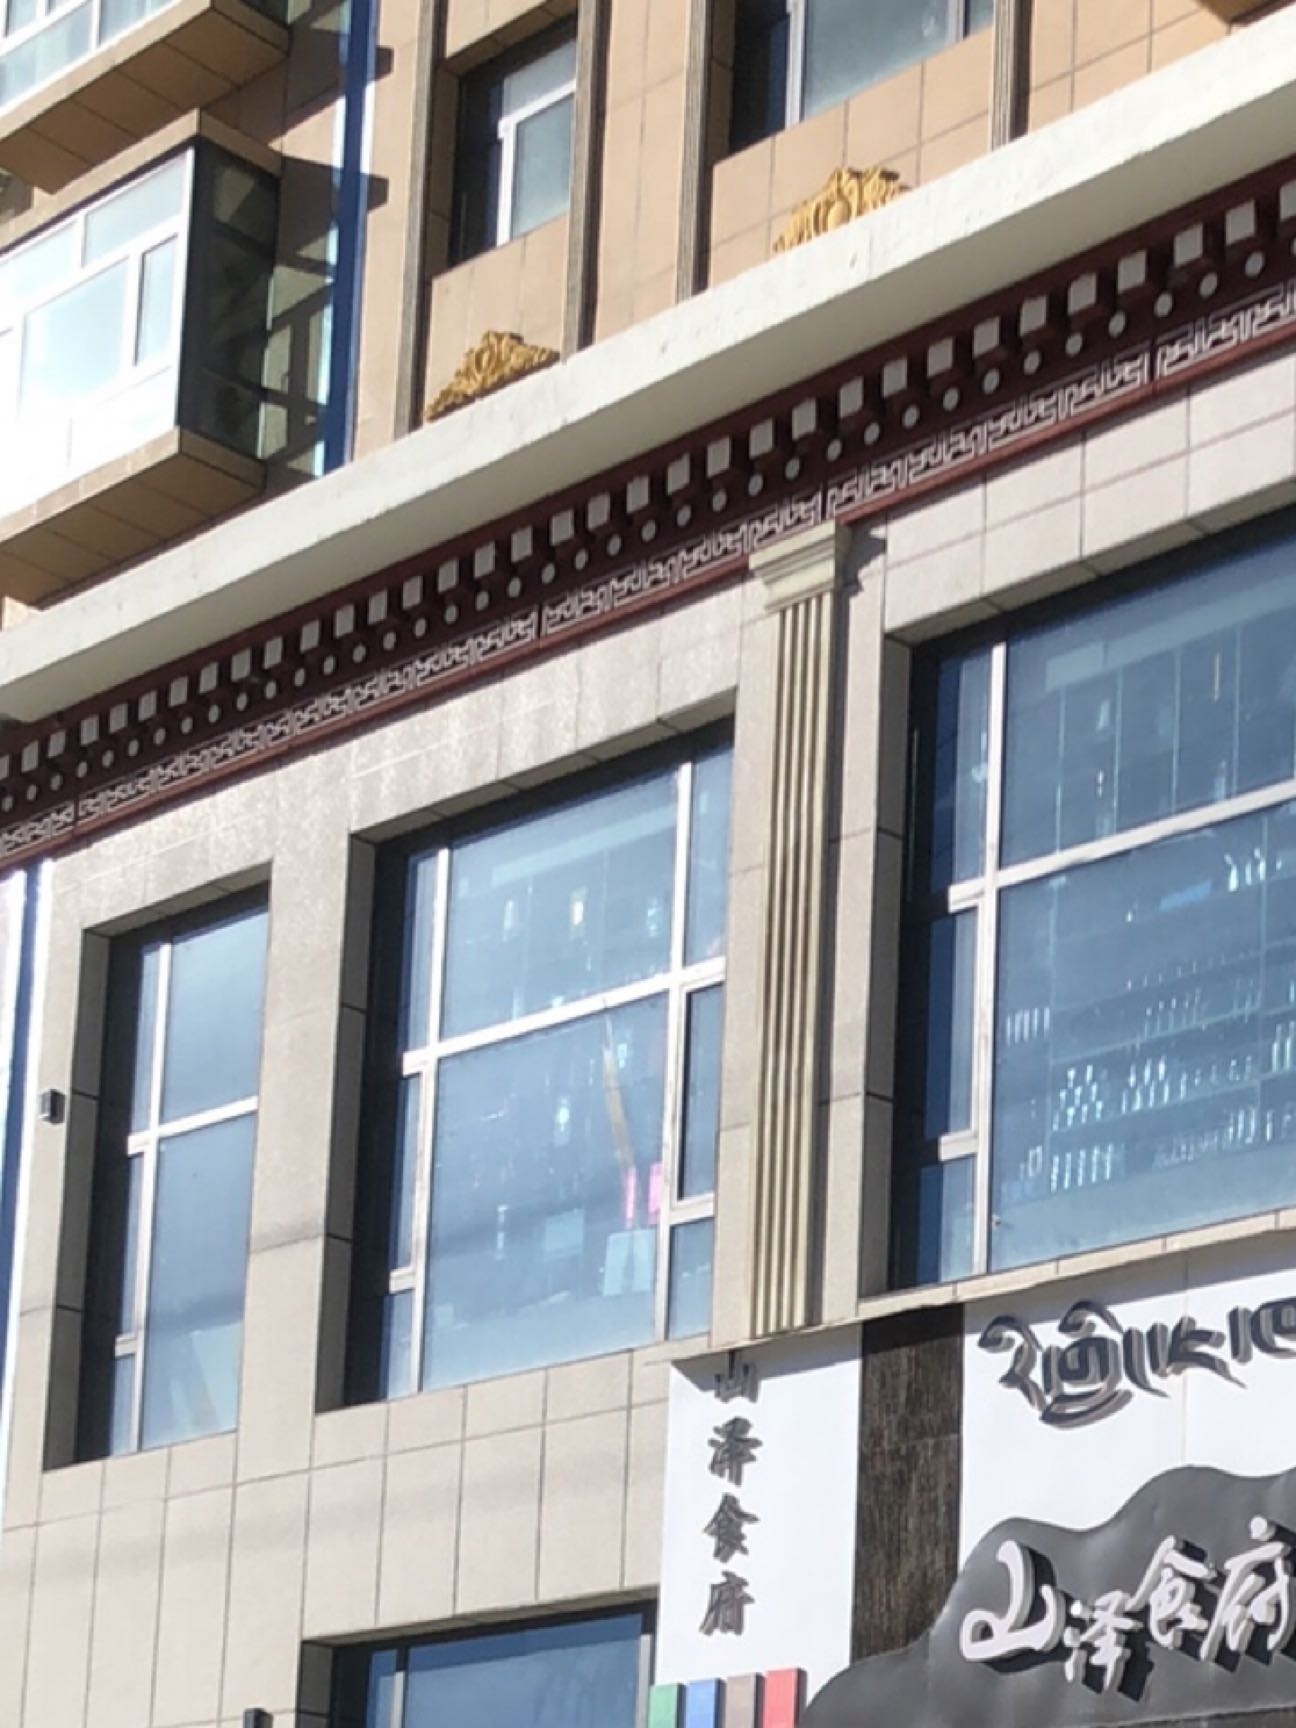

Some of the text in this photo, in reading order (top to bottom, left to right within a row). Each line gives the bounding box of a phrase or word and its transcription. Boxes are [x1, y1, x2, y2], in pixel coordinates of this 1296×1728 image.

[699, 1349, 764, 1637] 山泽食府
[959, 1514, 1296, 1692] 山泽食府
